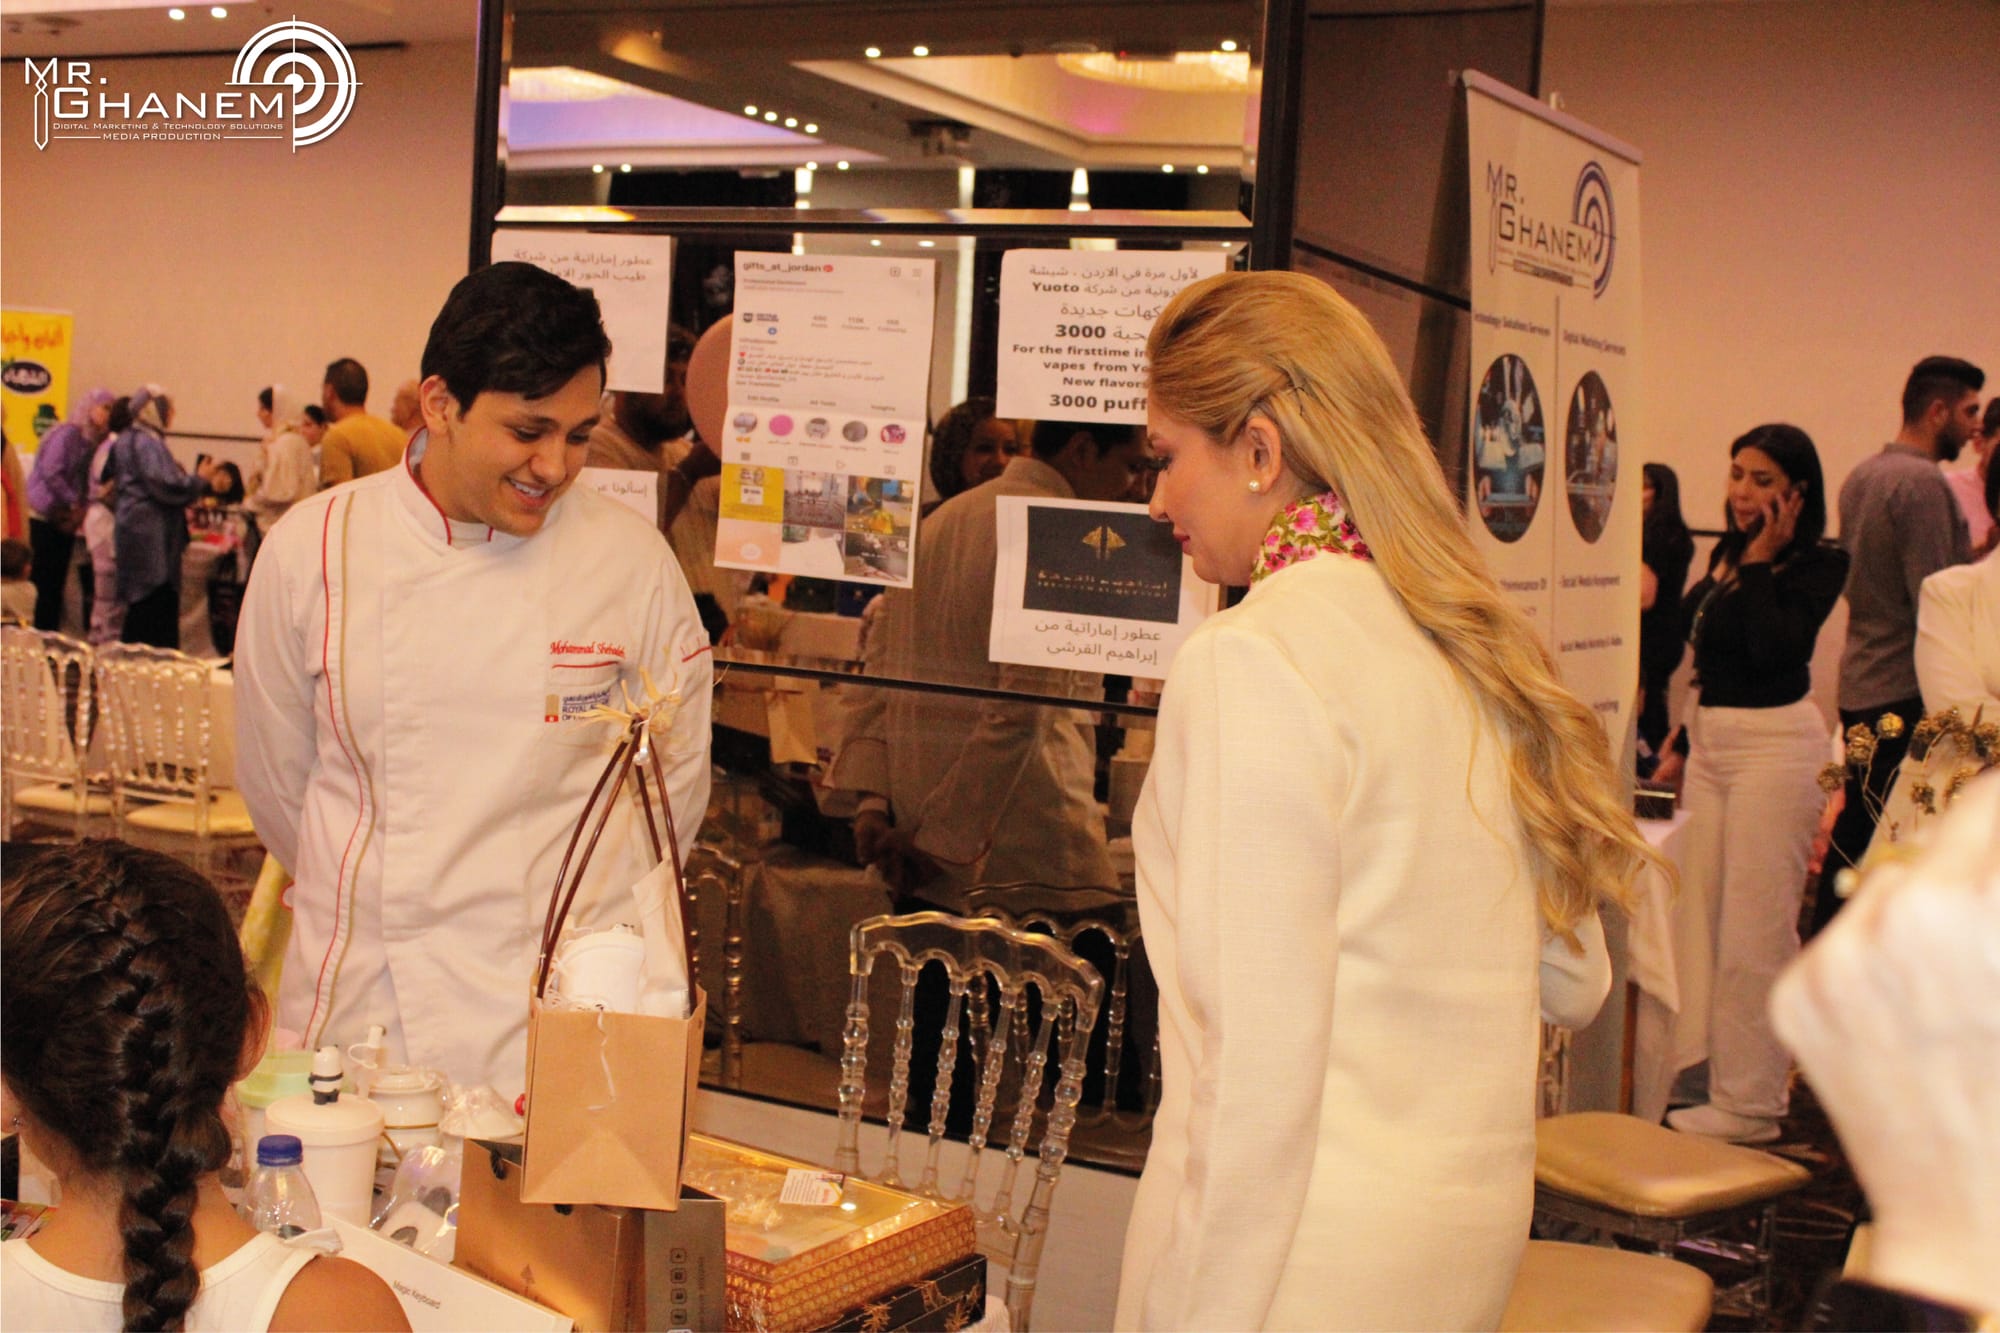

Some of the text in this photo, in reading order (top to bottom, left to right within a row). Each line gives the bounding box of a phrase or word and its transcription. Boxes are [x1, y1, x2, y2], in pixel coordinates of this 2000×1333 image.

[1499, 202, 1594, 267] GHANEM
[550, 253, 569, 264] من
[743, 262, 821, 273] gifts_at_jordan
[1144, 267, 1166, 281] مرة
[1032, 281, 1080, 293] Yuoto
[1084, 283, 1118, 296] شركة
[1121, 285, 1141, 298] من
[1060, 302, 1161, 321] كهات جديدة
[1055, 324, 1107, 339] 3000
[1012, 344, 1035, 355] For
[1039, 345, 1063, 356] the
[1043, 361, 1086, 374] vapes
[1093, 360, 1128, 373] from
[1062, 377, 1096, 388] New
[1049, 394, 1148, 412] 3000 puff
[1034, 619, 1161, 642] عطور إماراتية من
[1105, 647, 1158, 666] إبراهيم
[562, 705, 587, 714] ROYAL
